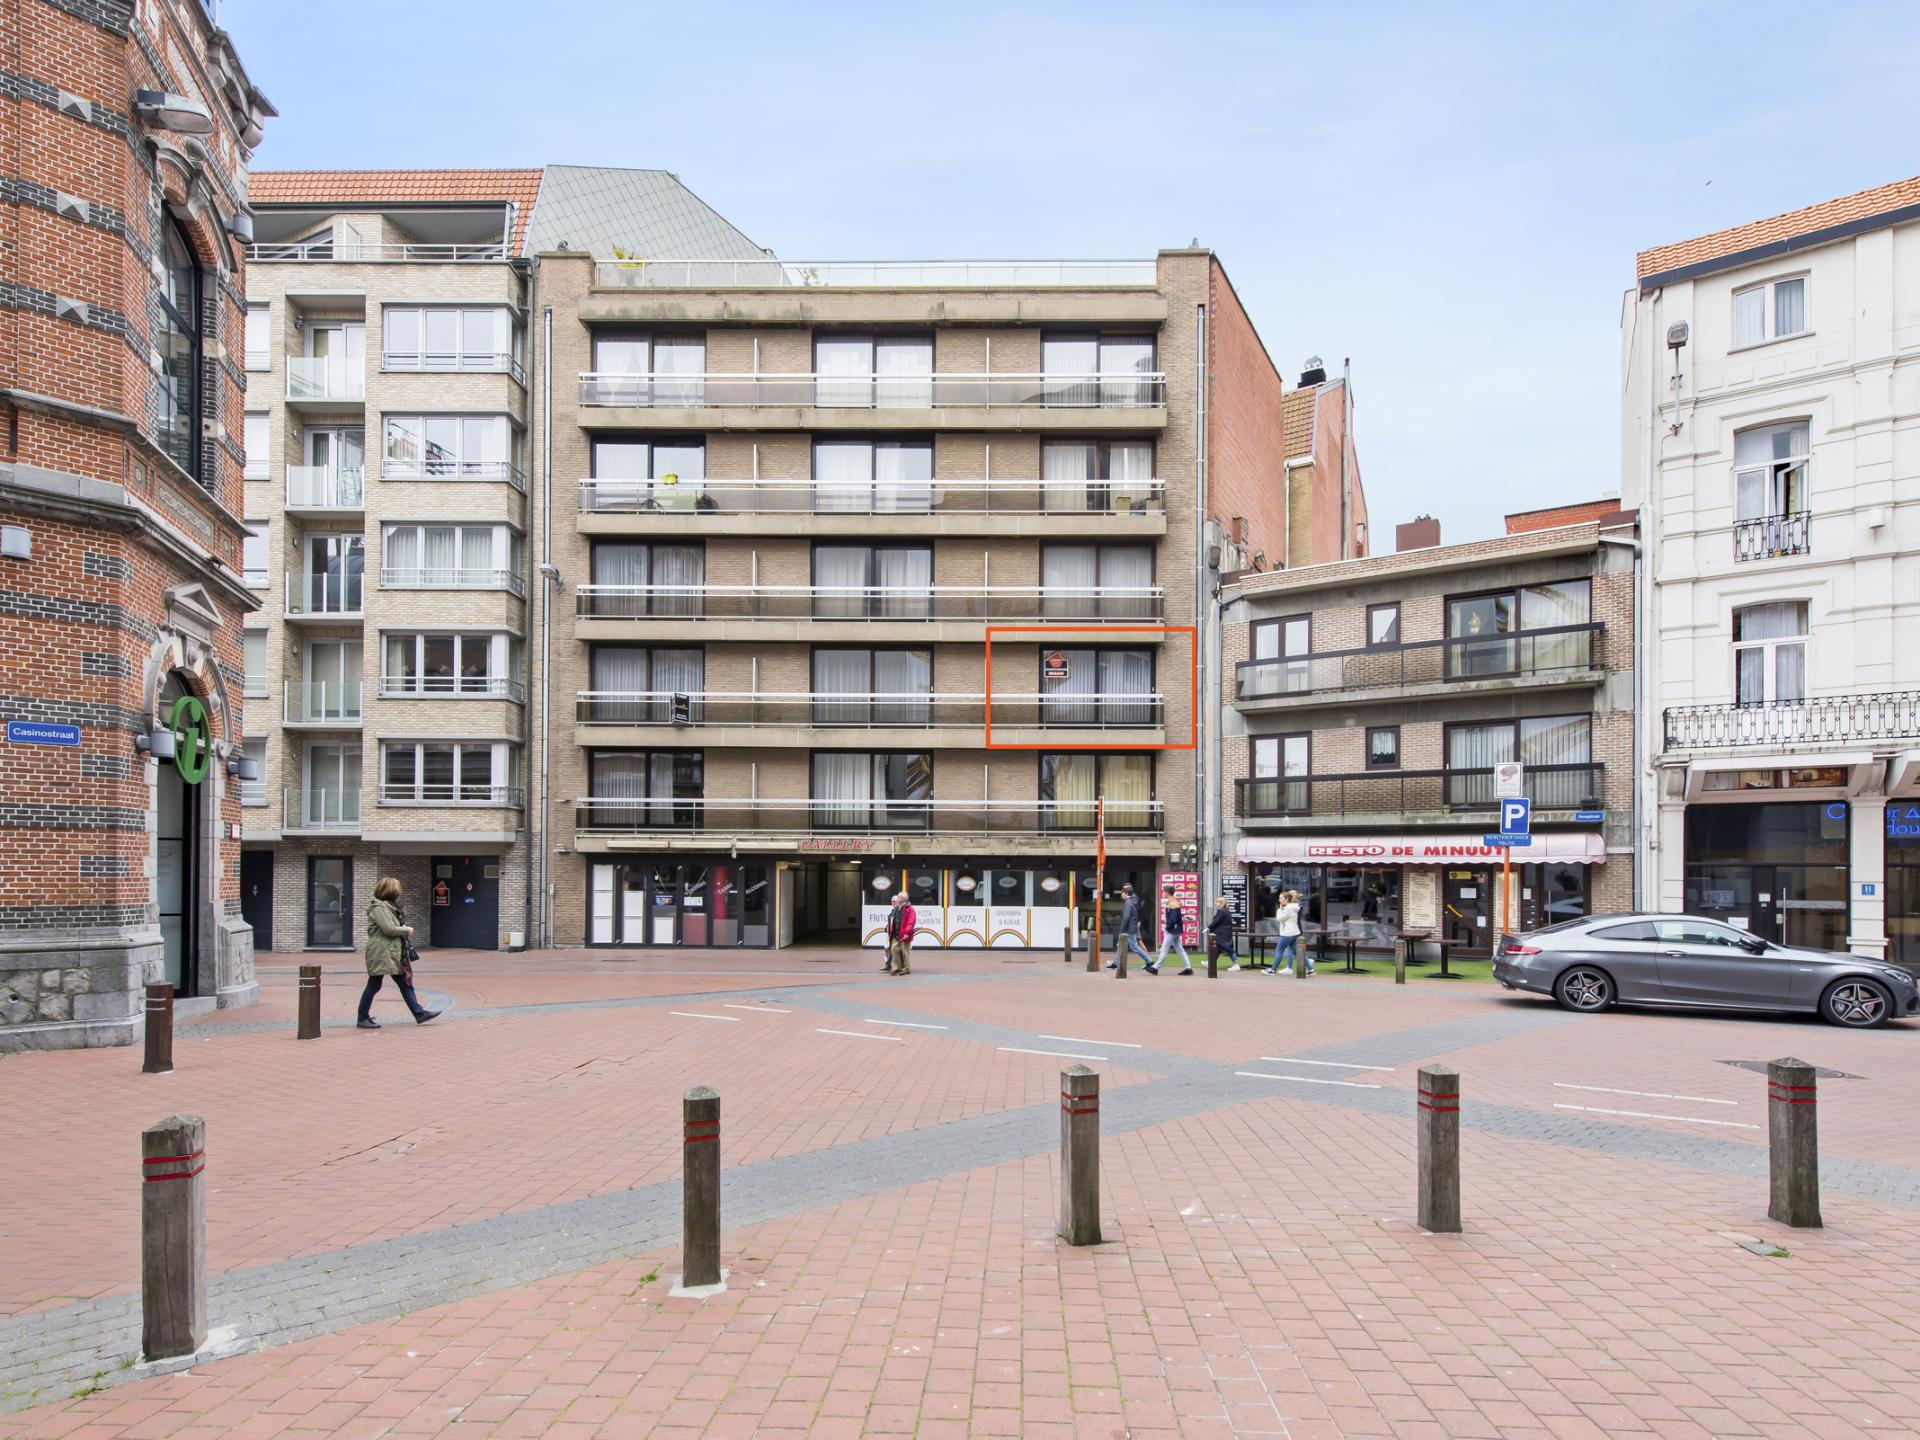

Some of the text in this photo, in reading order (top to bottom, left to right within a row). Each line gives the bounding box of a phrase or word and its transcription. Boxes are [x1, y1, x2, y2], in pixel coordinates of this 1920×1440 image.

[13, 727, 74, 739] Casinostraat
[1505, 804, 1526, 829] P
[801, 840, 875, 850] GALLERY
[1310, 846, 1505, 856] RESTO DE MINUUT
[956, 914, 977, 923] PIZZA
